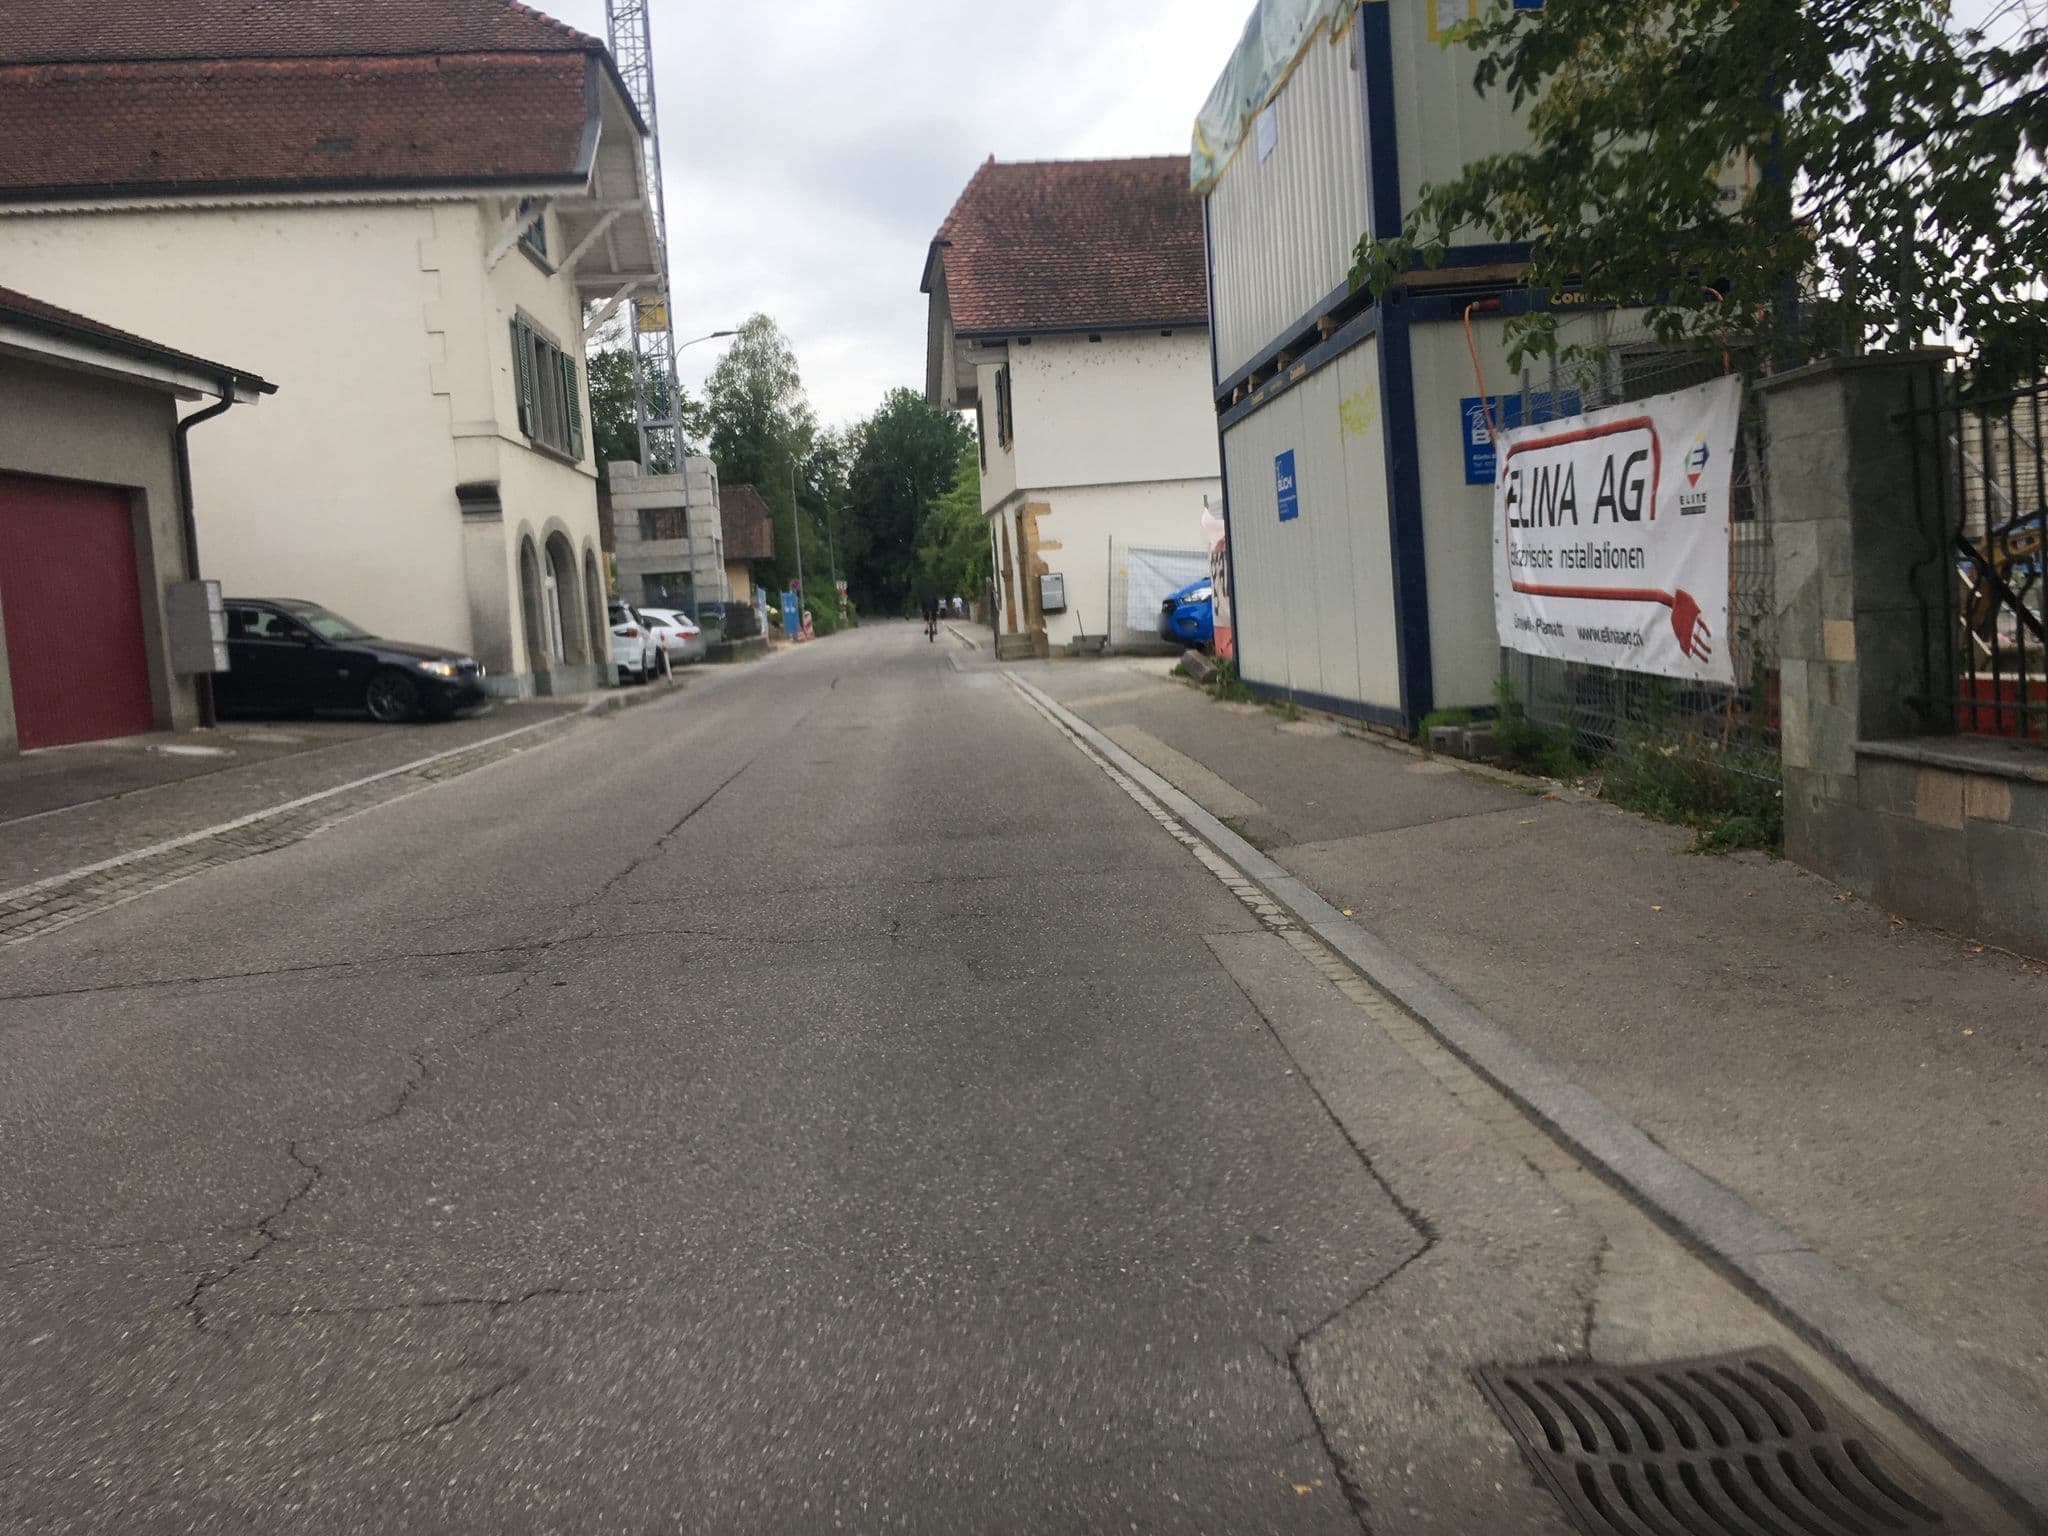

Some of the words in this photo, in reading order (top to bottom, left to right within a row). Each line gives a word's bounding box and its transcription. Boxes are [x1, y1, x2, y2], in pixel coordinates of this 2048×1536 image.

[1507, 461, 1578, 528] ELINA
[1593, 449, 1648, 524] AG
[1558, 541, 1645, 569] nstallationen
